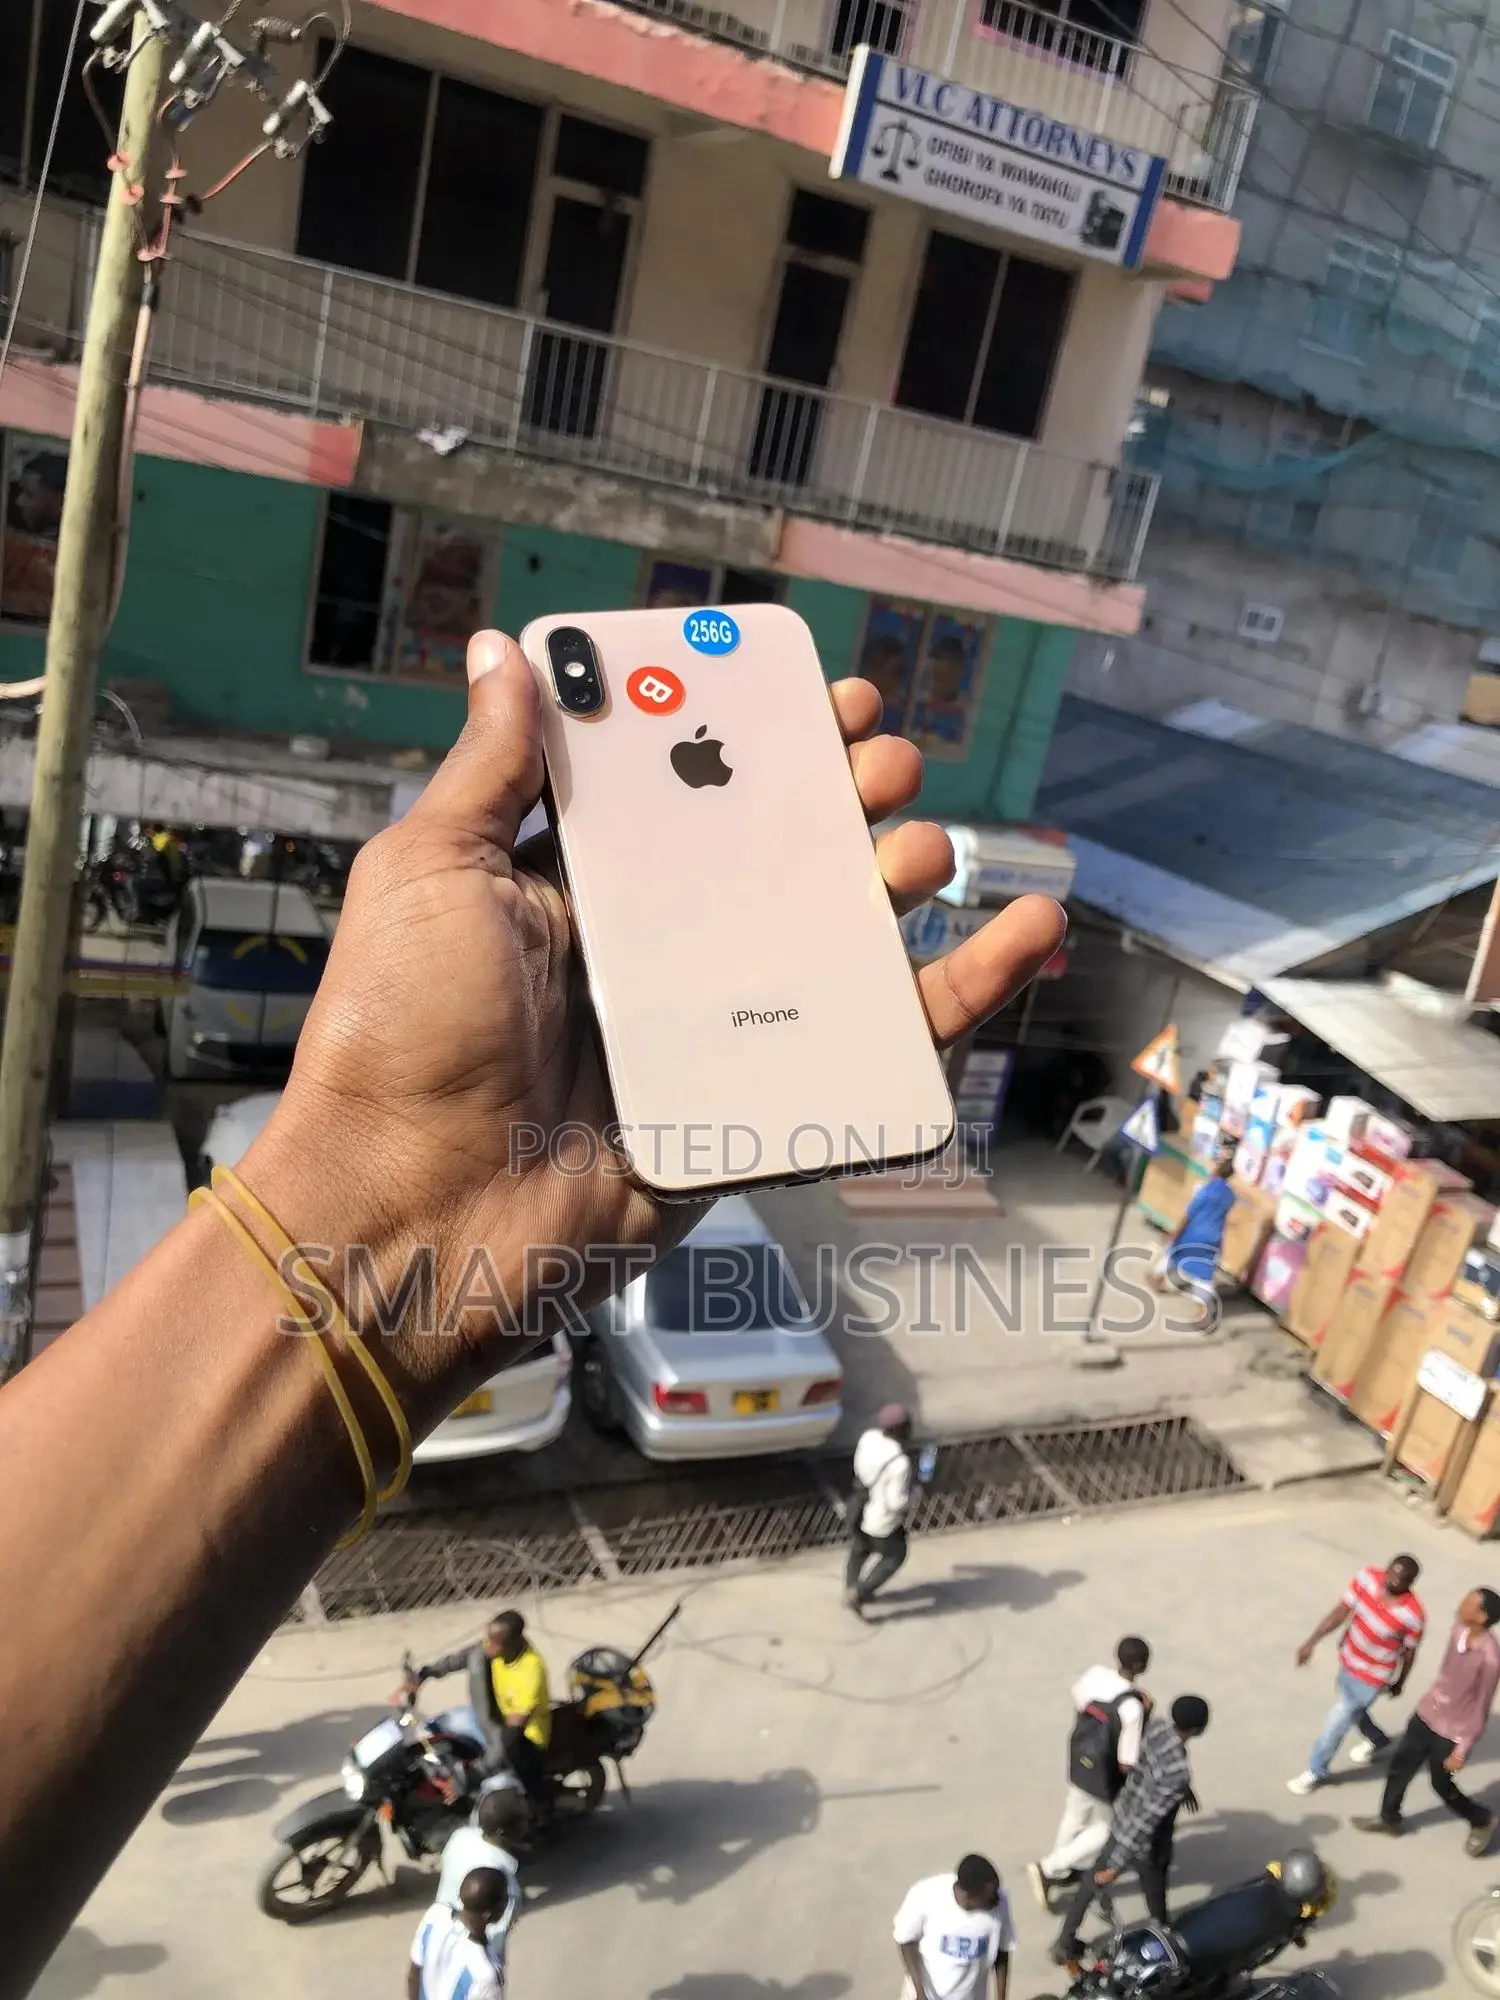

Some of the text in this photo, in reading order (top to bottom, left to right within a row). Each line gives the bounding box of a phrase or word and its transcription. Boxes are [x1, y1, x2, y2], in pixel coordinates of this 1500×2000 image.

[895, 66, 1139, 182] VLC ATTORNEYS
[689, 619, 733, 644] 256G
[731, 1008, 800, 1027] iPhone
